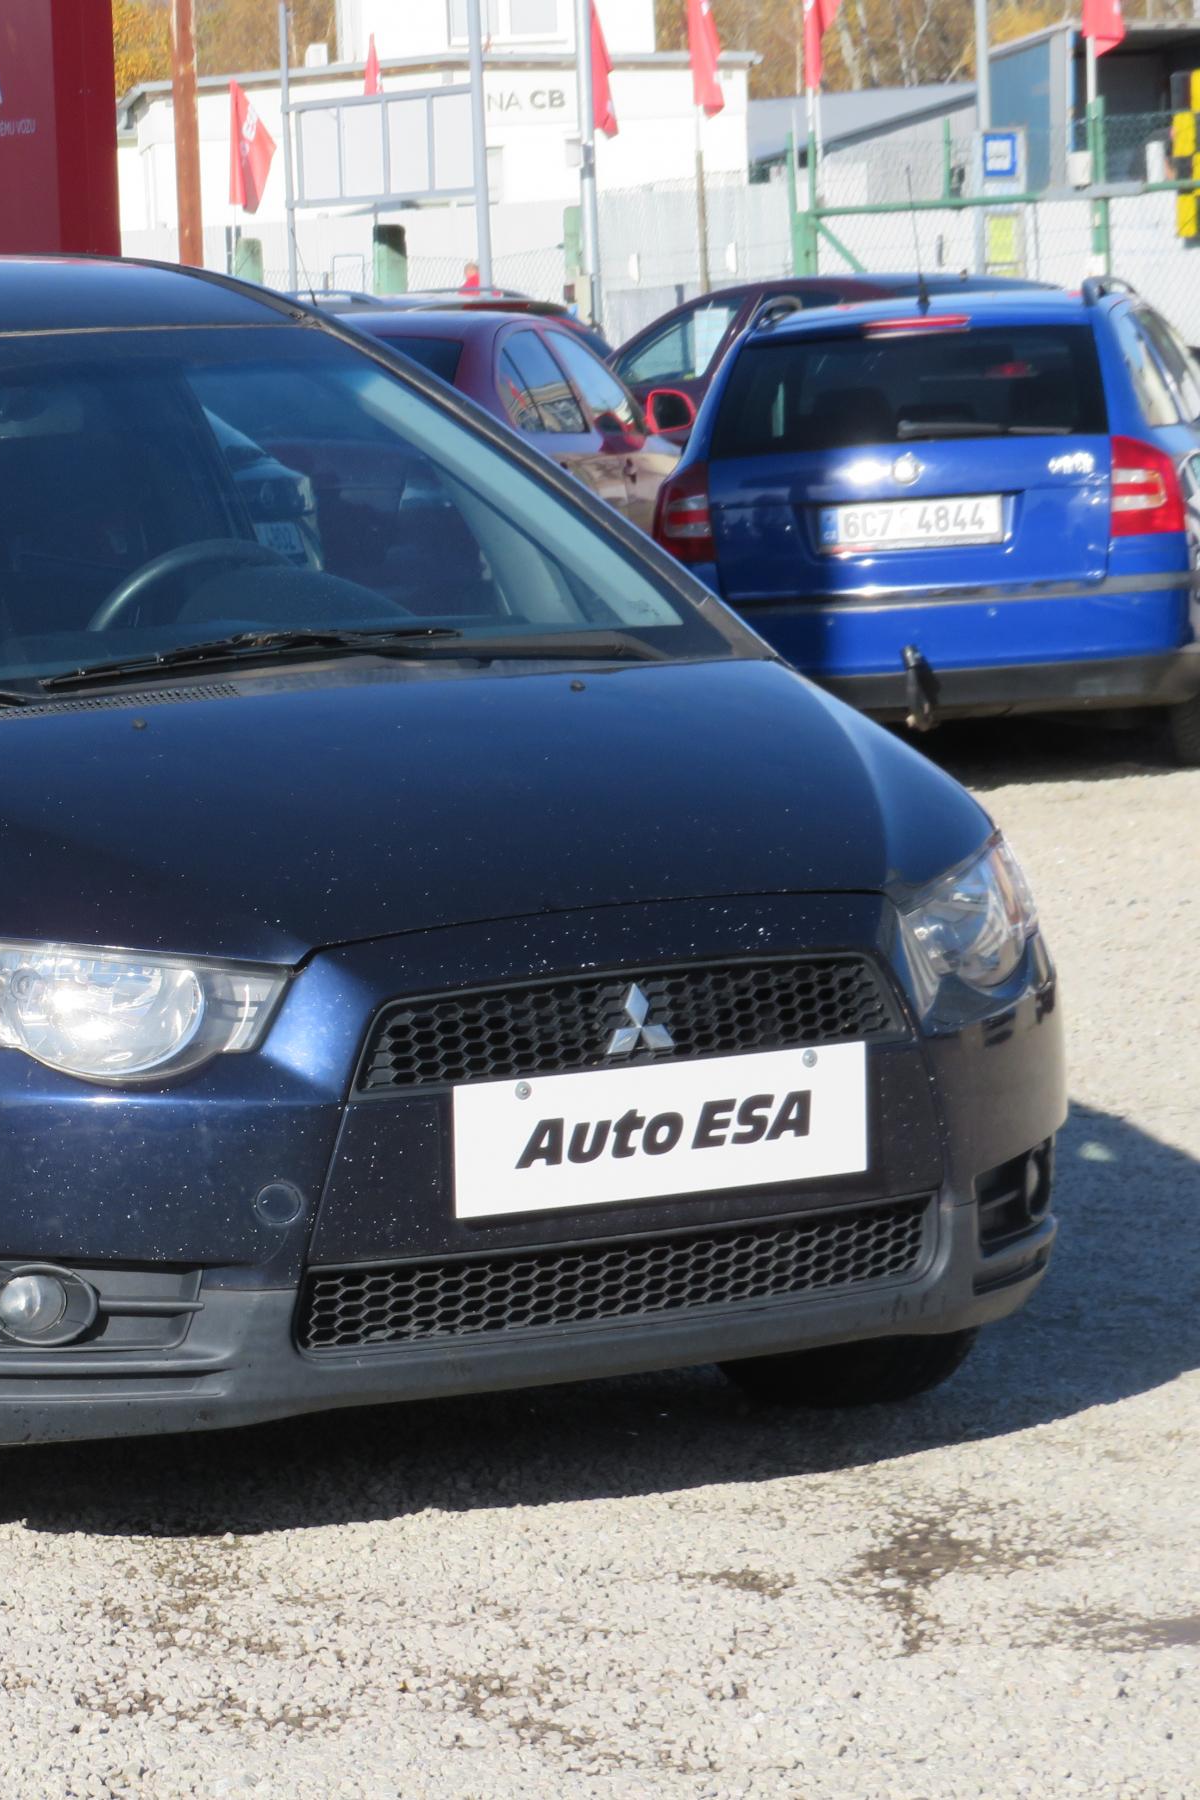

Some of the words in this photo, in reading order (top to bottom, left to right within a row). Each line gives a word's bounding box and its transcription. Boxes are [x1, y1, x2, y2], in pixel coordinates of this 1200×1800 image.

[529, 88, 567, 110] CB
[843, 508, 893, 539] 6C7
[917, 501, 985, 534] 4844
[514, 1108, 685, 1169] Auto
[691, 1089, 812, 1150] ESA
